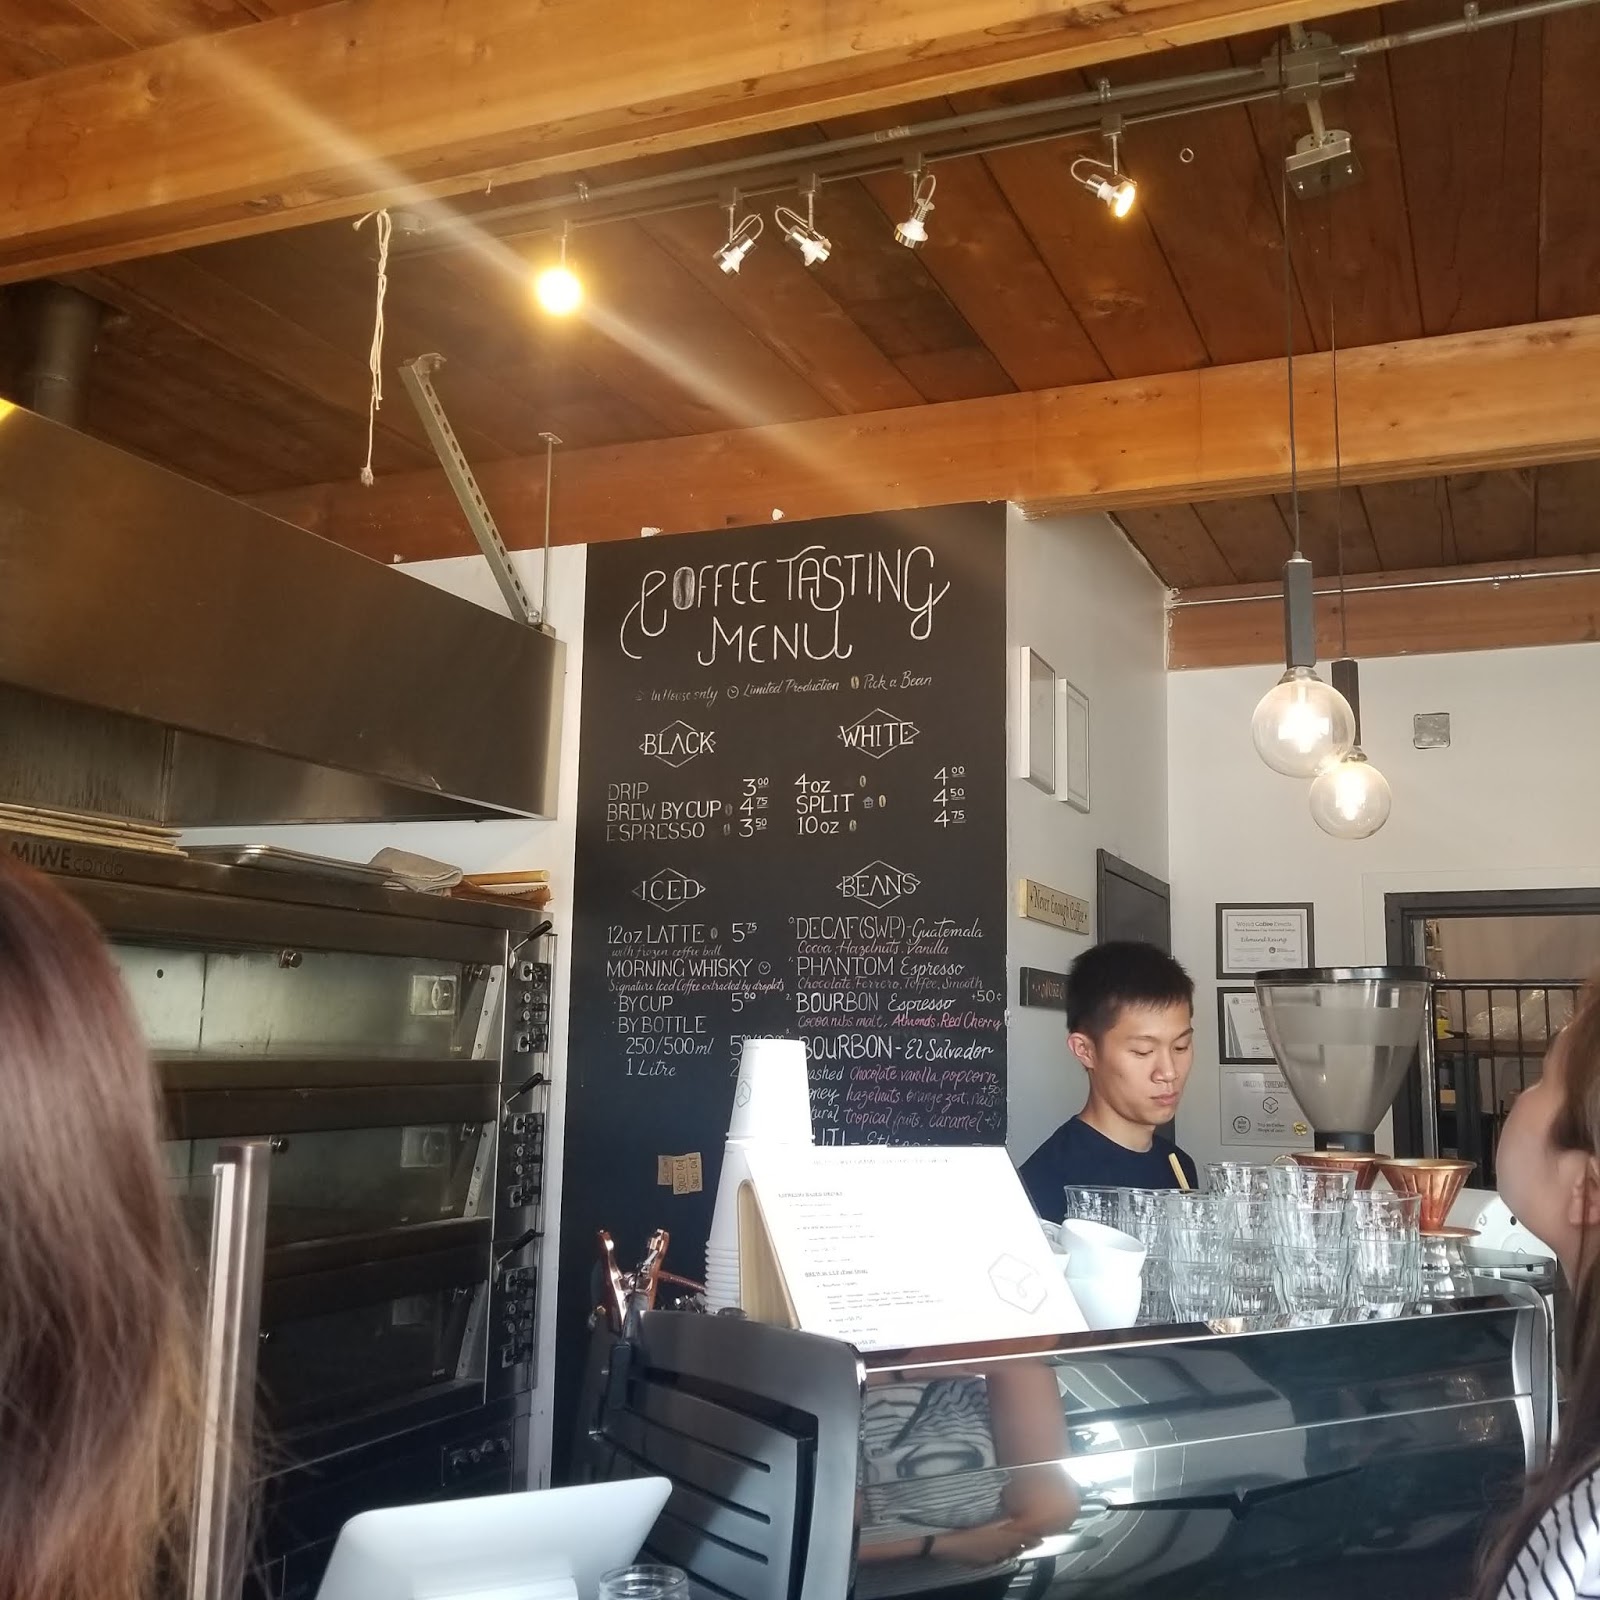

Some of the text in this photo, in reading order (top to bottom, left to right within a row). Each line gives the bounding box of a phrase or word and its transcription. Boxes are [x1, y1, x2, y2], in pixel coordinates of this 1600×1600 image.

[620, 545, 950, 659] COFFEE TASTING
[697, 610, 853, 666] MENU
[743, 678, 840, 698] Limited Production
[863, 670, 932, 690] Pick a Bean
[643, 730, 716, 755] BLACK
[839, 721, 915, 749] WHITE
[608, 781, 650, 801] DRIP
[794, 772, 832, 795] 4oz
[606, 802, 656, 822] BREW
[796, 792, 855, 815] SPLIT
[606, 821, 705, 842] ESPRESSO
[797, 814, 840, 836] 10oz
[10, 841, 71, 870] MIWE
[641, 877, 700, 902] ICED
[841, 871, 918, 898] BEANS
[1033, 885, 1050, 910] Never
[1050, 894, 1070, 927] Enough
[607, 923, 705, 945] 12oz LATTE
[611, 944, 722, 960] with frozen coffee ball
[906, 939, 949, 955] Vanilla
[606, 958, 754, 977] MORNING WHISKY
[797, 956, 894, 976] PHANTOM
[900, 956, 965, 982] Espresso
[608, 979, 655, 996] Signature
[676, 979, 700, 996] Coffee
[702, 980, 740, 991] extracted
[752, 978, 785, 994] droplets
[942, 976, 983, 990] Smooth
[796, 992, 879, 1013] BOURBON
[887, 992, 957, 1018] Espresso
[641, 1015, 707, 1034] BOTTLE
[942, 1013, 962, 1027] Red
[963, 1011, 1002, 1031] Cherry
[799, 1034, 893, 1060] BOURBON
[905, 1038, 923, 1059] El
[924, 1039, 994, 1061] Salvador
[625, 1058, 677, 1076] 1 Litre
[806, 1064, 845, 1081] ashed
[940, 1066, 999, 1091] popcorn
[808, 1087, 840, 1106] oney
[843, 1106, 893, 1130] tropical
[929, 1111, 982, 1132] caramel
